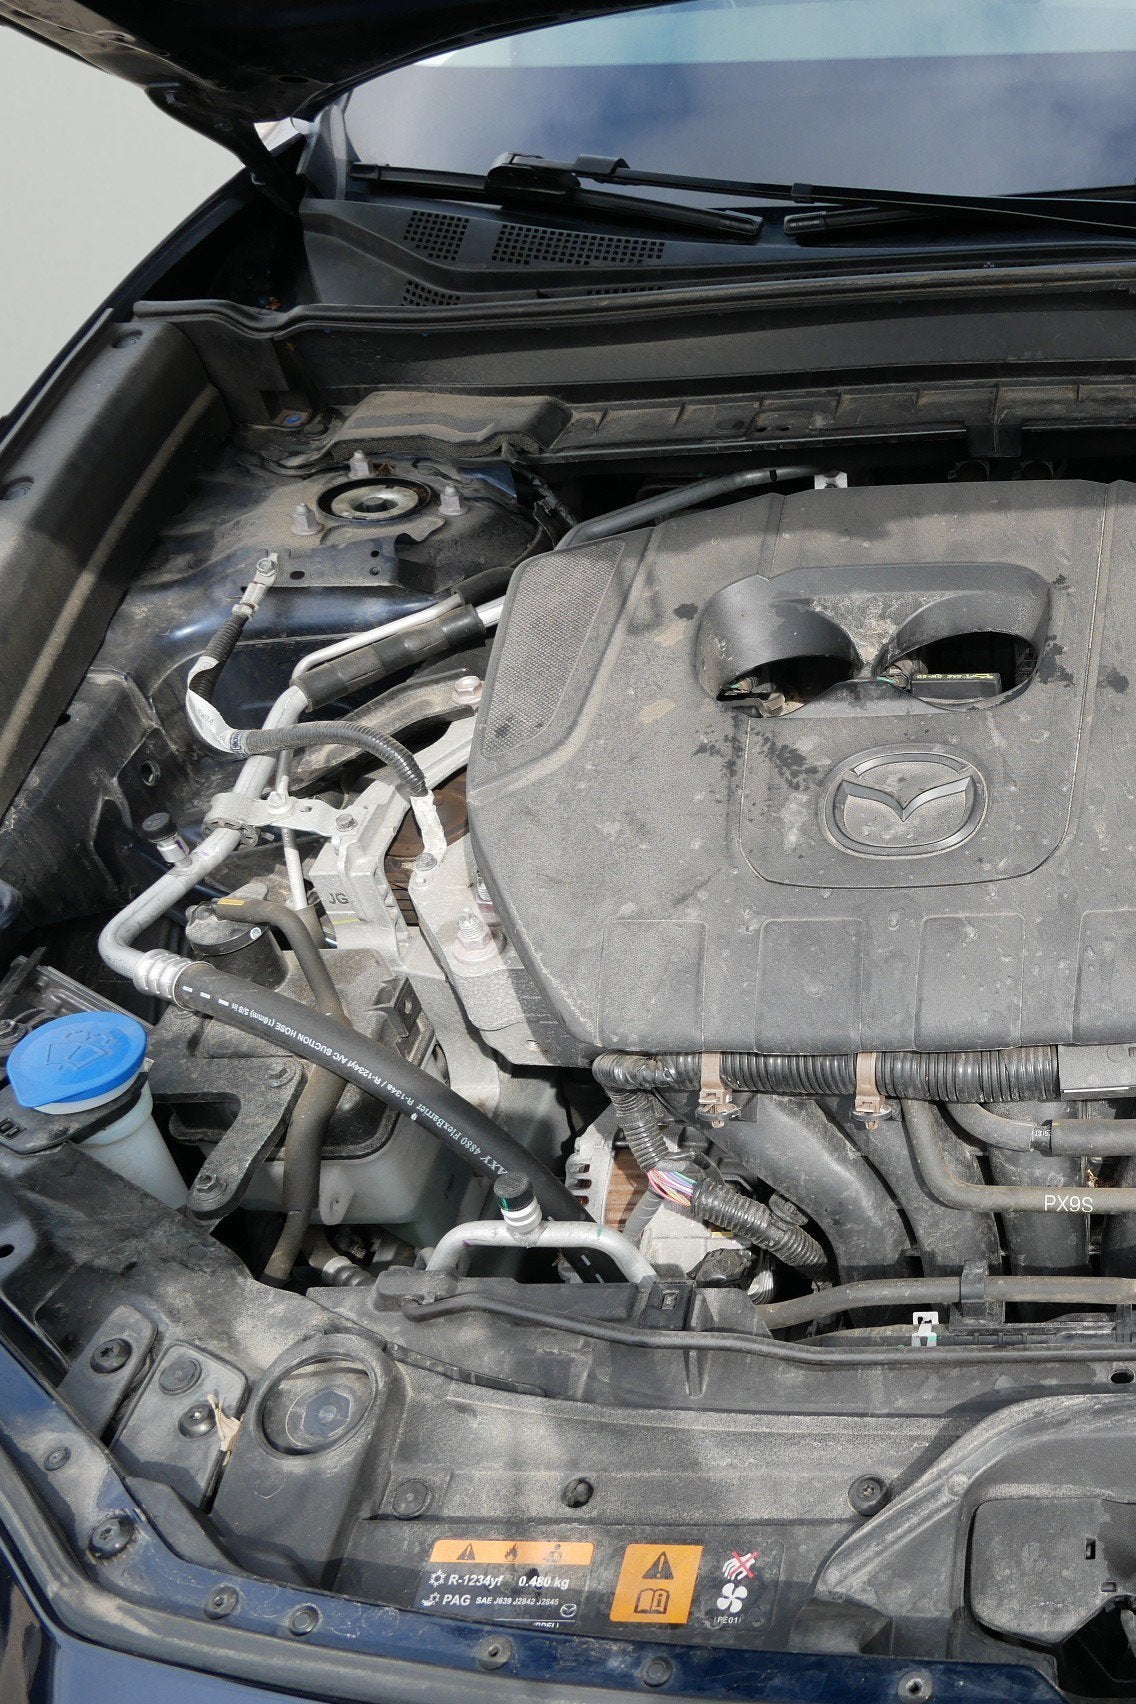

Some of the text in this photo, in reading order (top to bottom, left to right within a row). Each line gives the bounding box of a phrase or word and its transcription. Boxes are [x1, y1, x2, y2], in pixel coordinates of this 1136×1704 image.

[231, 1002, 238, 1012] in
[238, 1006, 250, 1016] 5/8
[250, 1009, 276, 1027] (16mm)
[275, 1022, 297, 1038] HOSE
[297, 1033, 333, 1056] SUCTION
[332, 1052, 348, 1064] A/C
[347, 1058, 382, 1085] R-1234yf
[386, 1084, 415, 1106] R-134a
[416, 1104, 462, 1140] FlexBarrier
[1044, 1194, 1094, 1213] PX9S
[448, 1574, 570, 1590] R-1234yf 0.480 kg
[442, 1595, 471, 1606] PAG
[494, 1597, 512, 1605] J639
[536, 1598, 559, 1606] J2845
